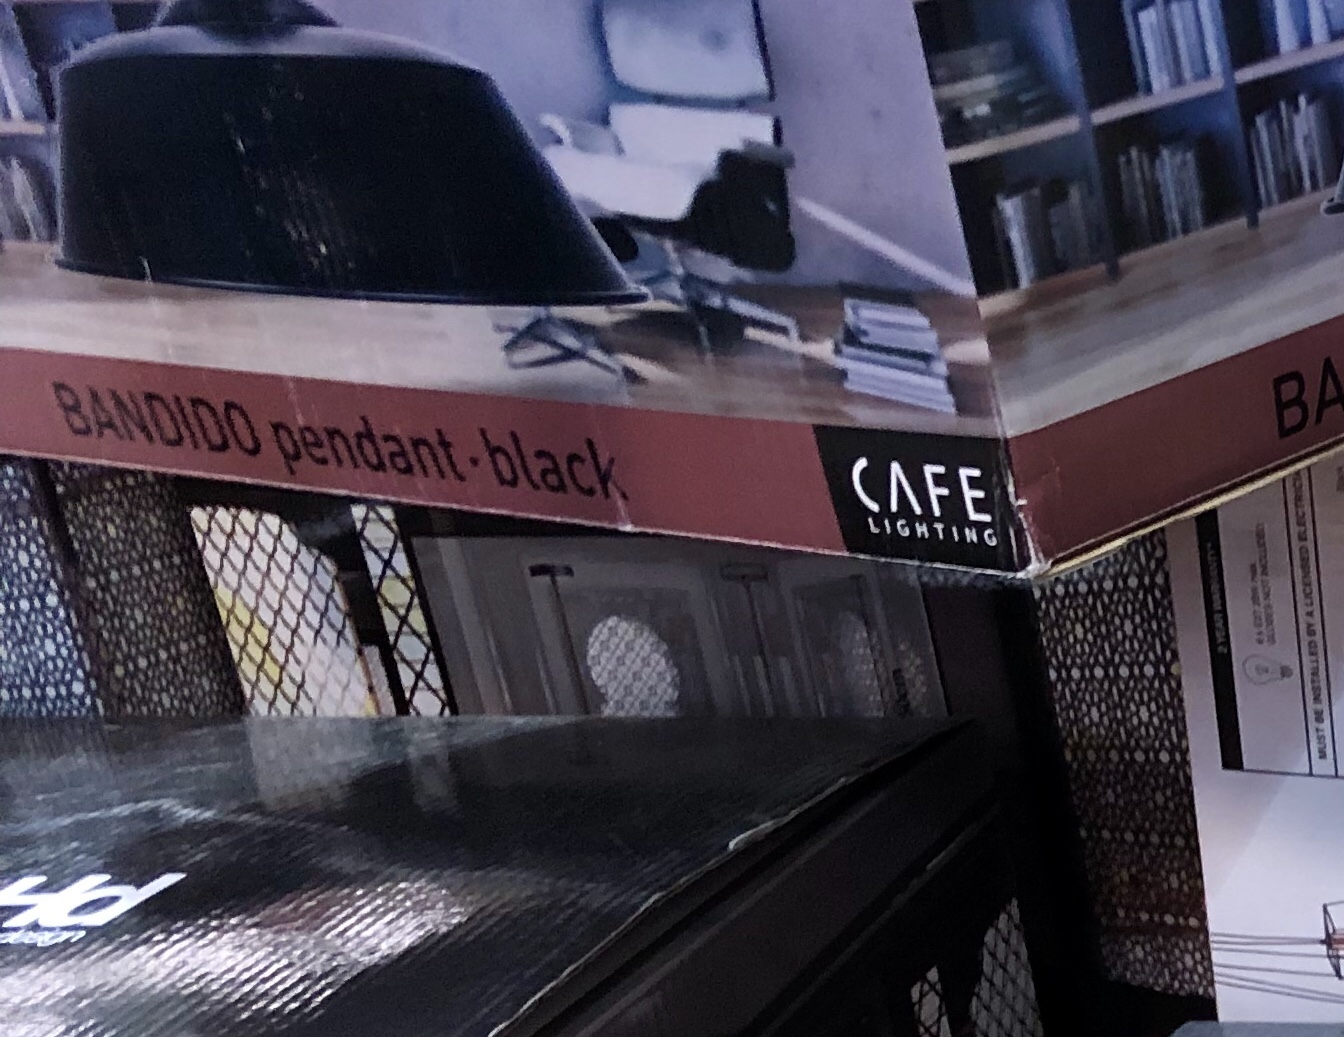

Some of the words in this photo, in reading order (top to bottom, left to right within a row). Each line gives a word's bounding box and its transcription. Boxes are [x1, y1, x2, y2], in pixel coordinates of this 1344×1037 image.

[52, 381, 262, 457] BANDIDO
[852, 456, 993, 523] CAFE
[867, 517, 998, 547] LIGHTING
[1299, 545, 1314, 607] LICENSED
[1305, 610, 1315, 618] A
[1305, 622, 1317, 637] BY
[1307, 640, 1322, 705] INSTALLED
[1313, 708, 1325, 724] BE
[1315, 727, 1328, 760] MUST
